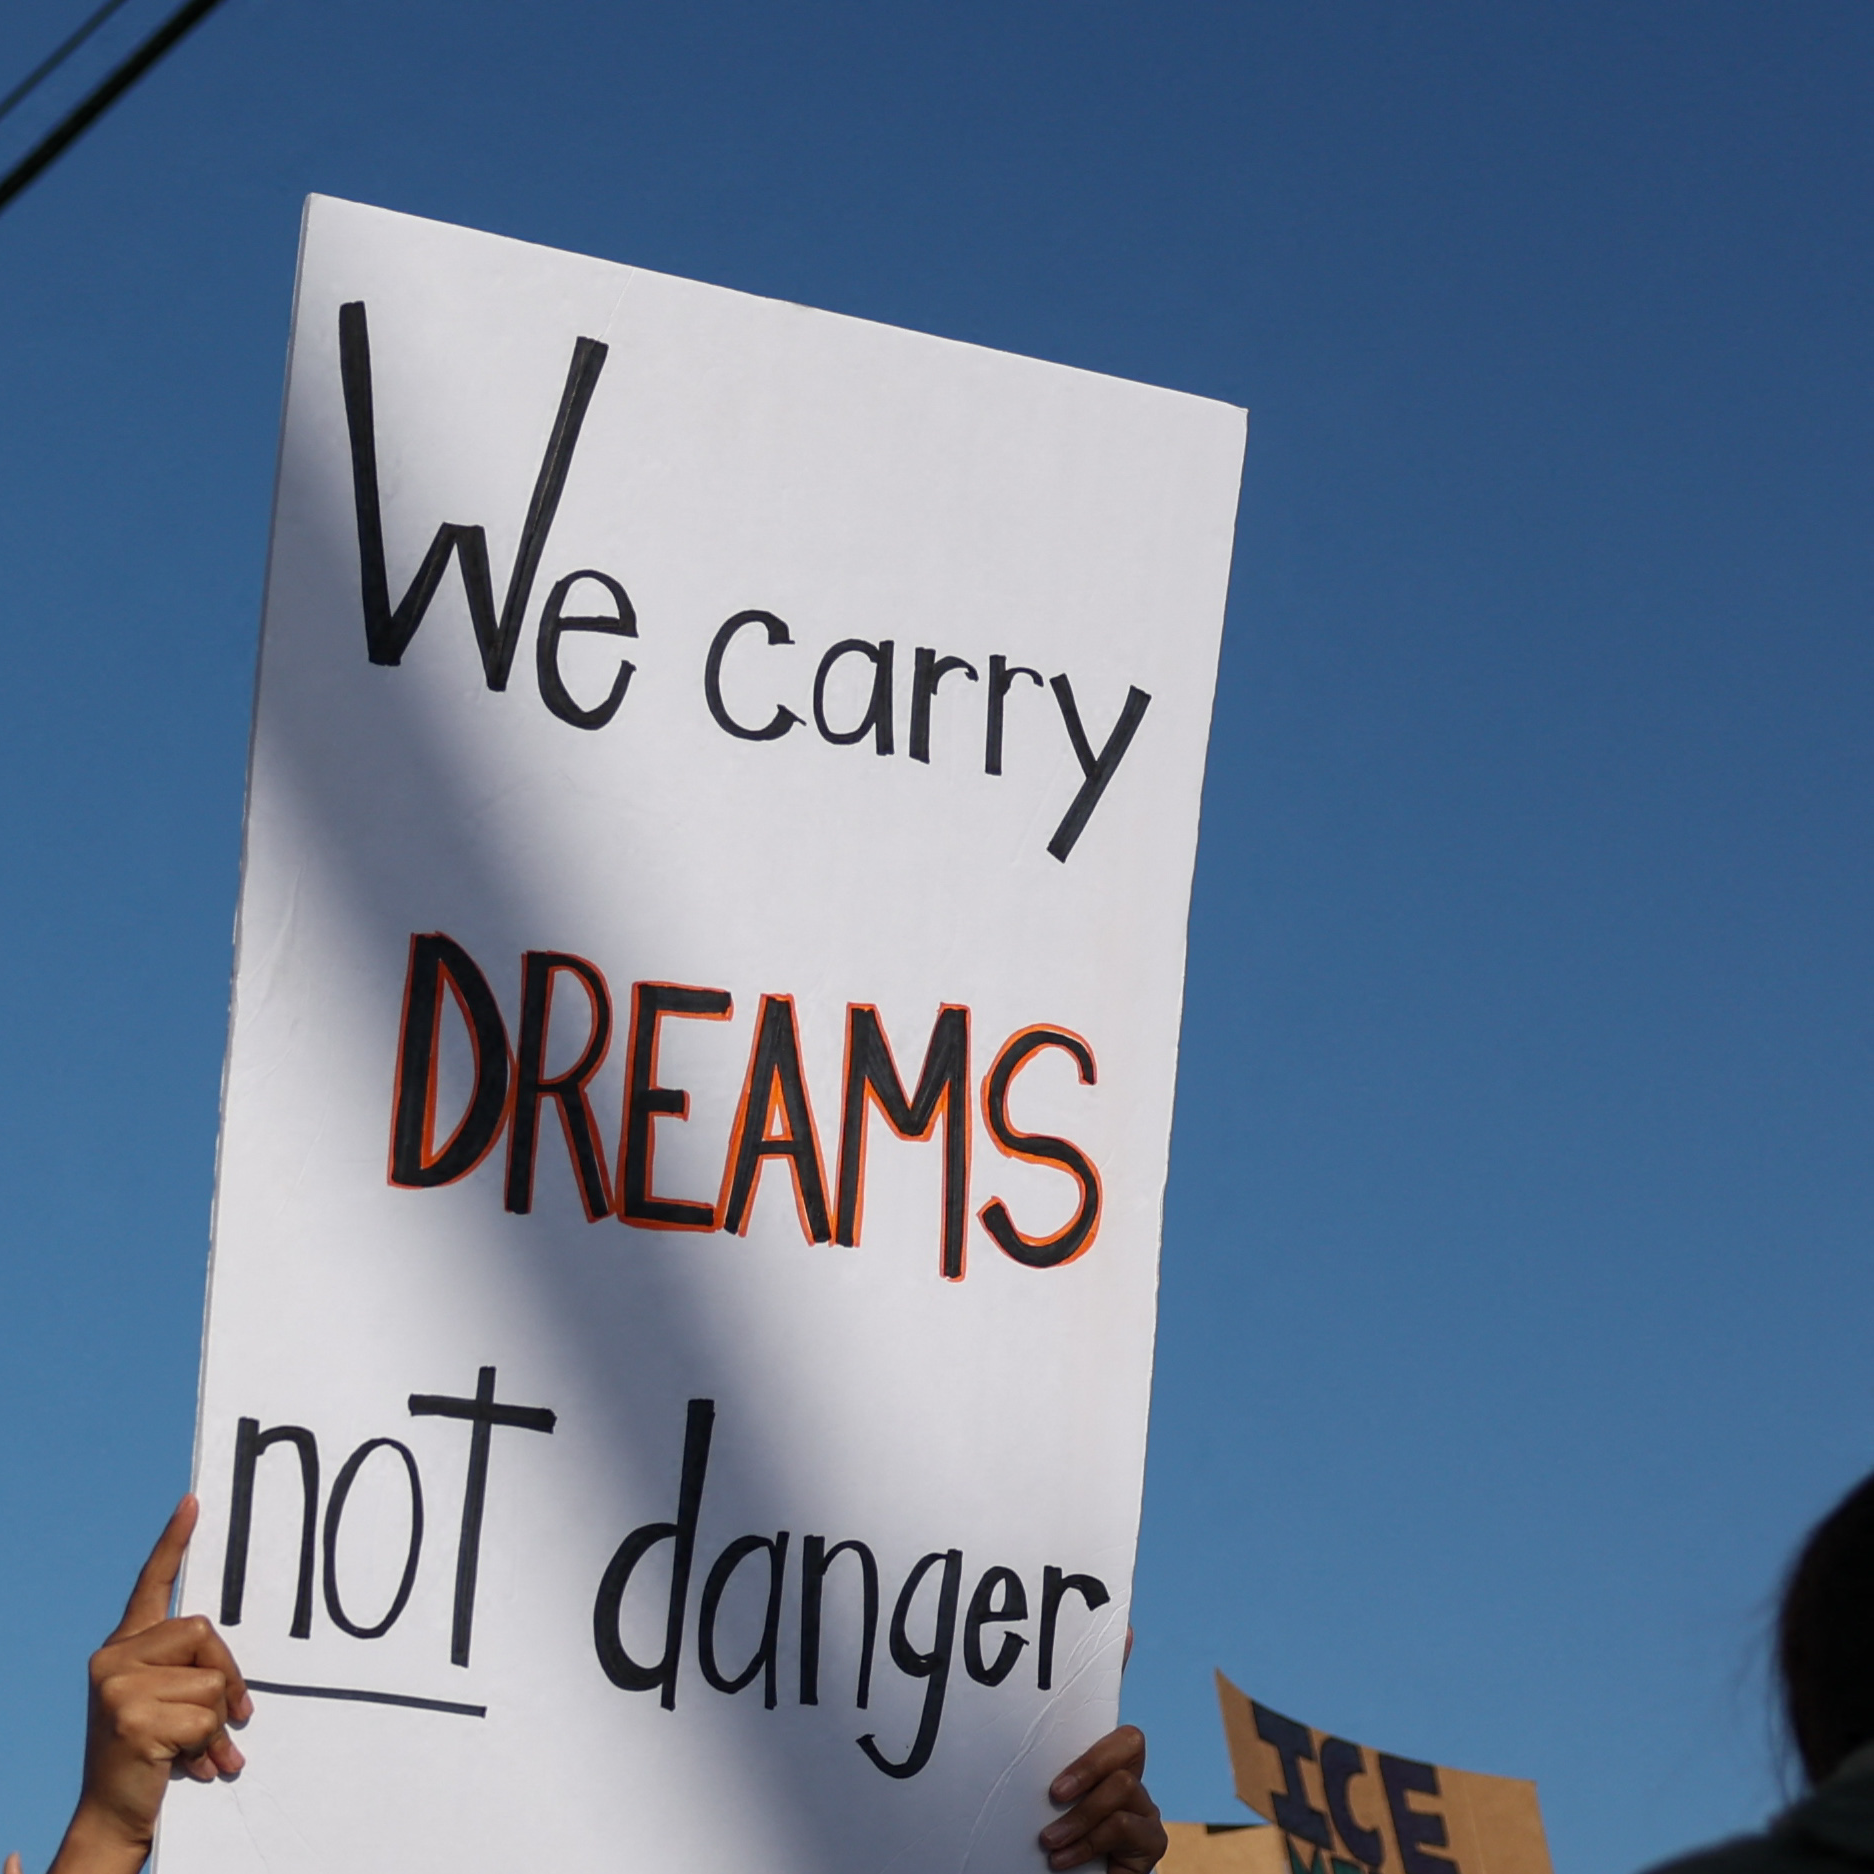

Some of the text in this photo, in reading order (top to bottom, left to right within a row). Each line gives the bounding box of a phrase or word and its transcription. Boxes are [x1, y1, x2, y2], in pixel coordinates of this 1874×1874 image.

[339, 301, 1152, 863] We carry
[388, 931, 1103, 1281] DREAMS
[222, 1366, 1112, 1780] not danger
